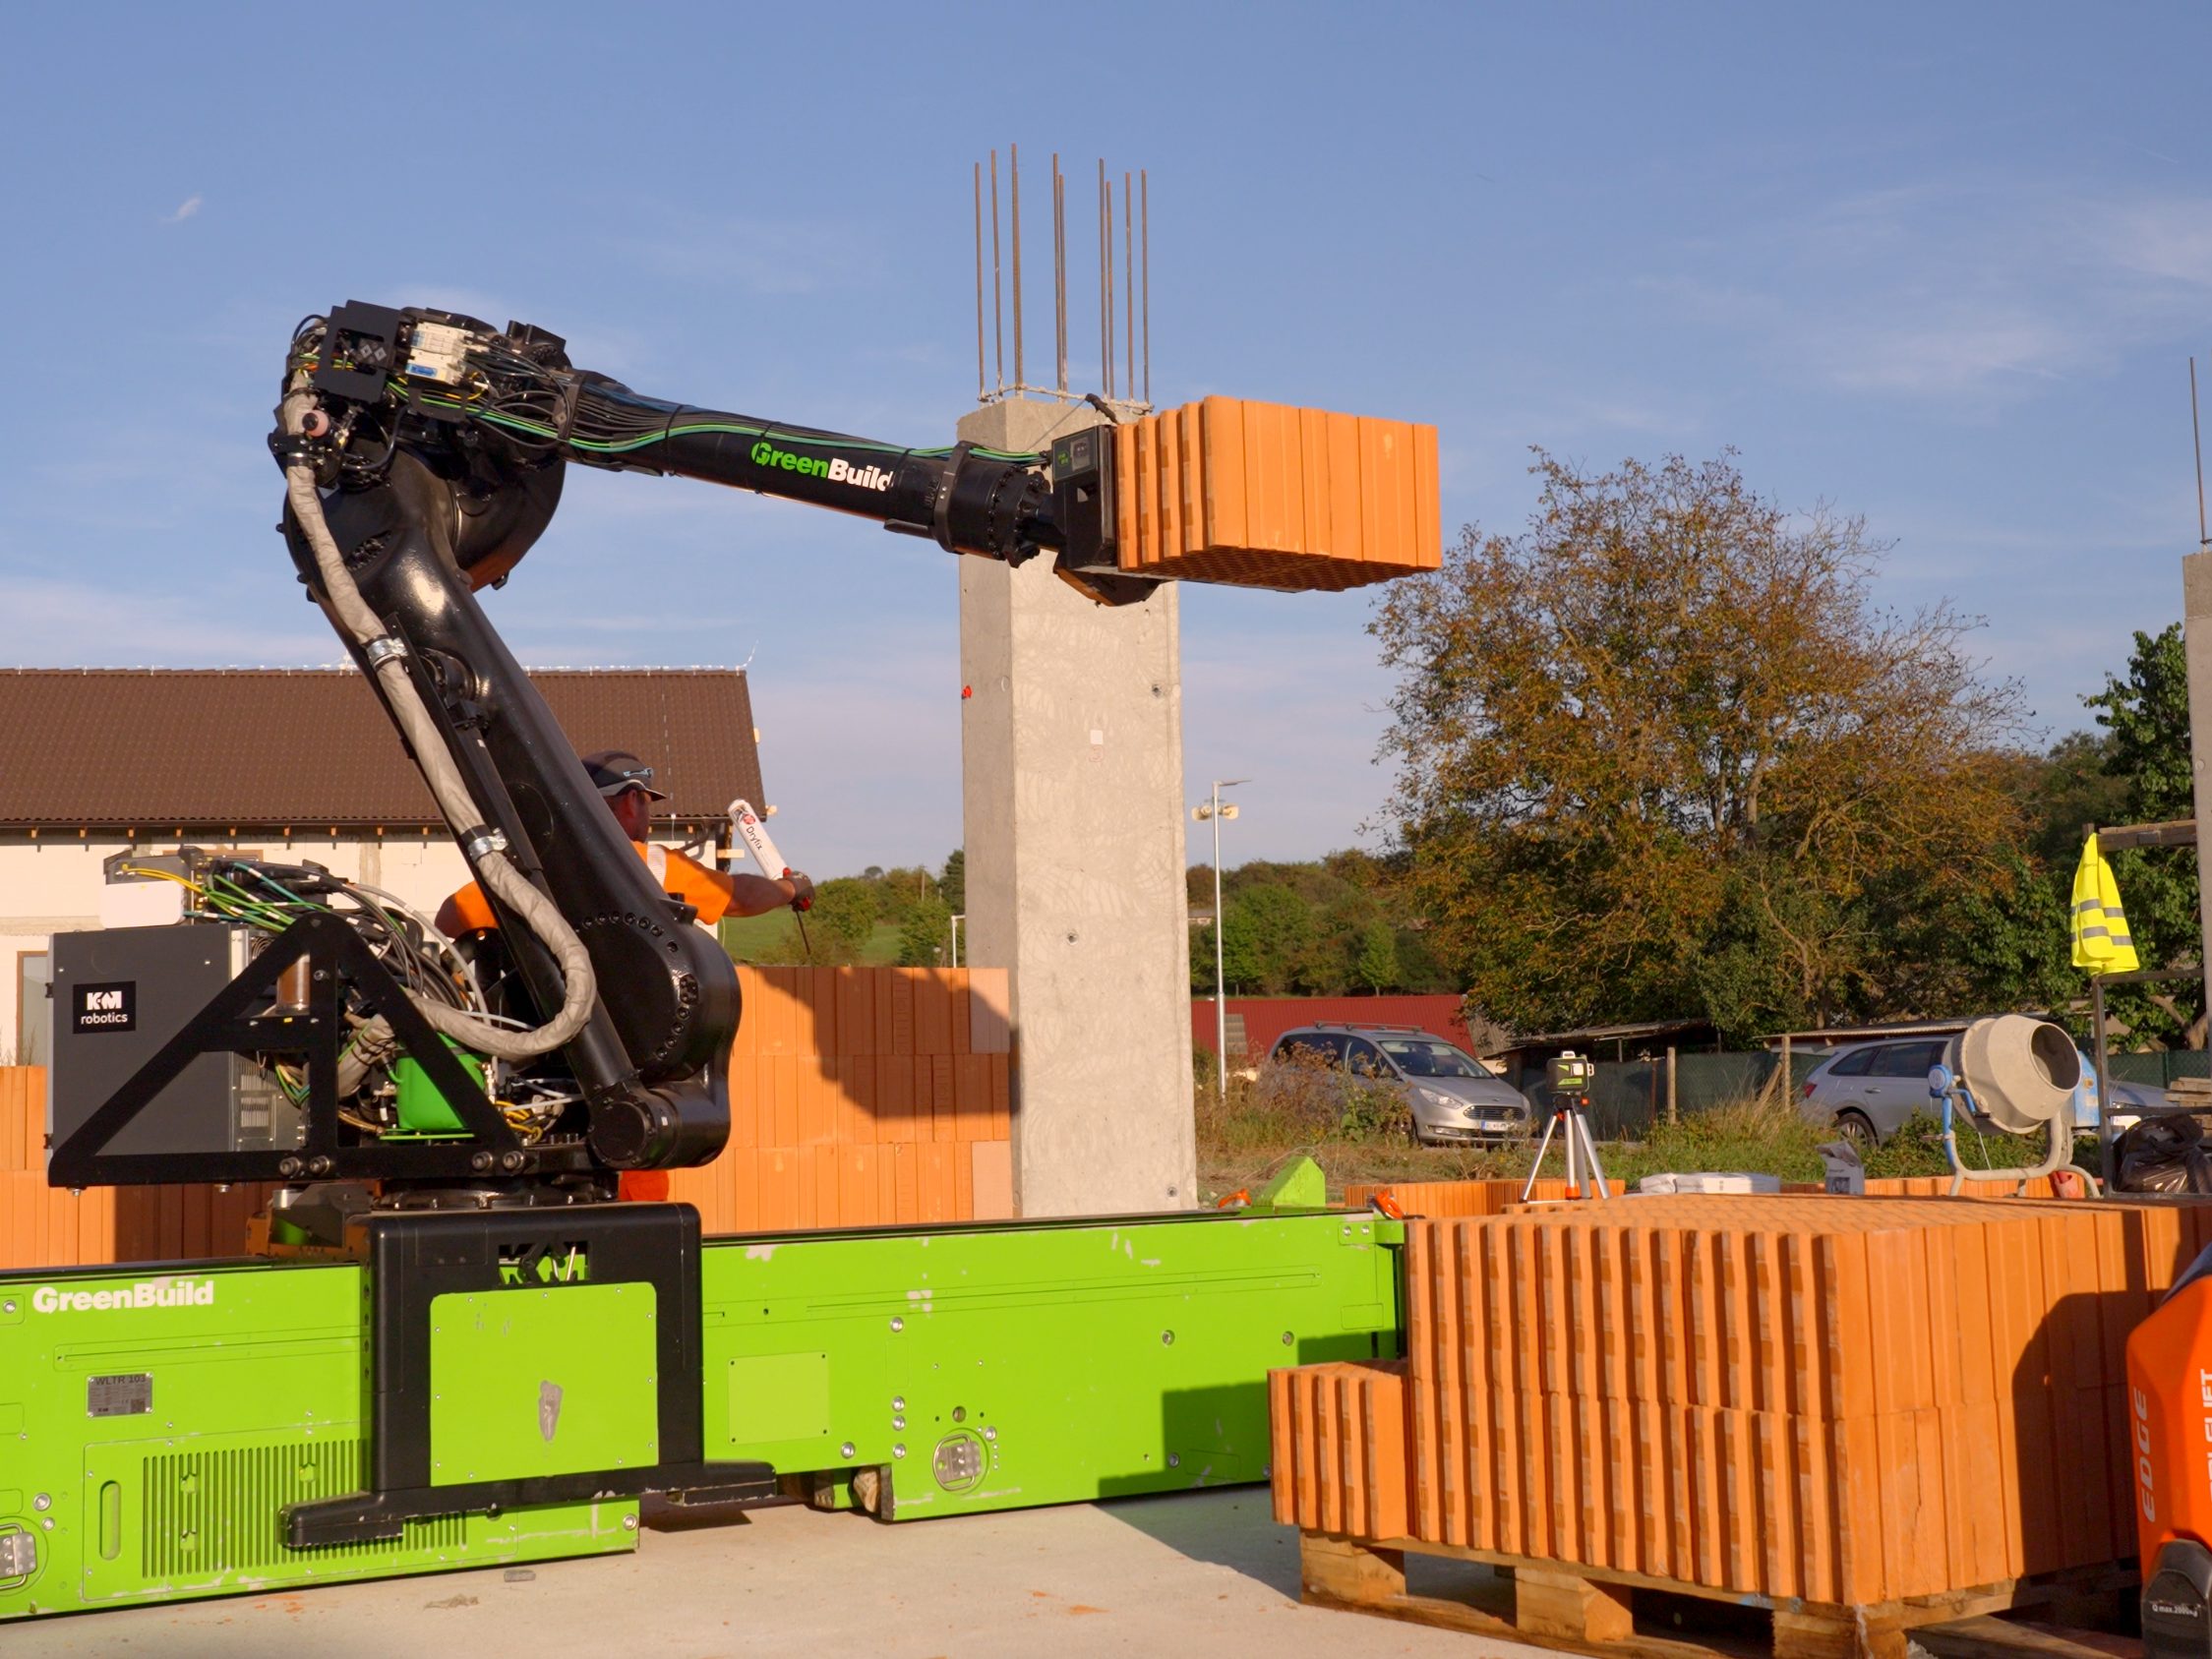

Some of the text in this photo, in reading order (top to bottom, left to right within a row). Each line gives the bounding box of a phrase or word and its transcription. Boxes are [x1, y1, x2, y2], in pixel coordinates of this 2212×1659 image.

[751, 443, 894, 492] GreenBuild
[746, 826, 762, 850] Dryfix
[81, 1012, 128, 1025] robotics
[32, 1280, 213, 1314] GreenBuild
[2133, 1387, 2156, 1522] EDGE
